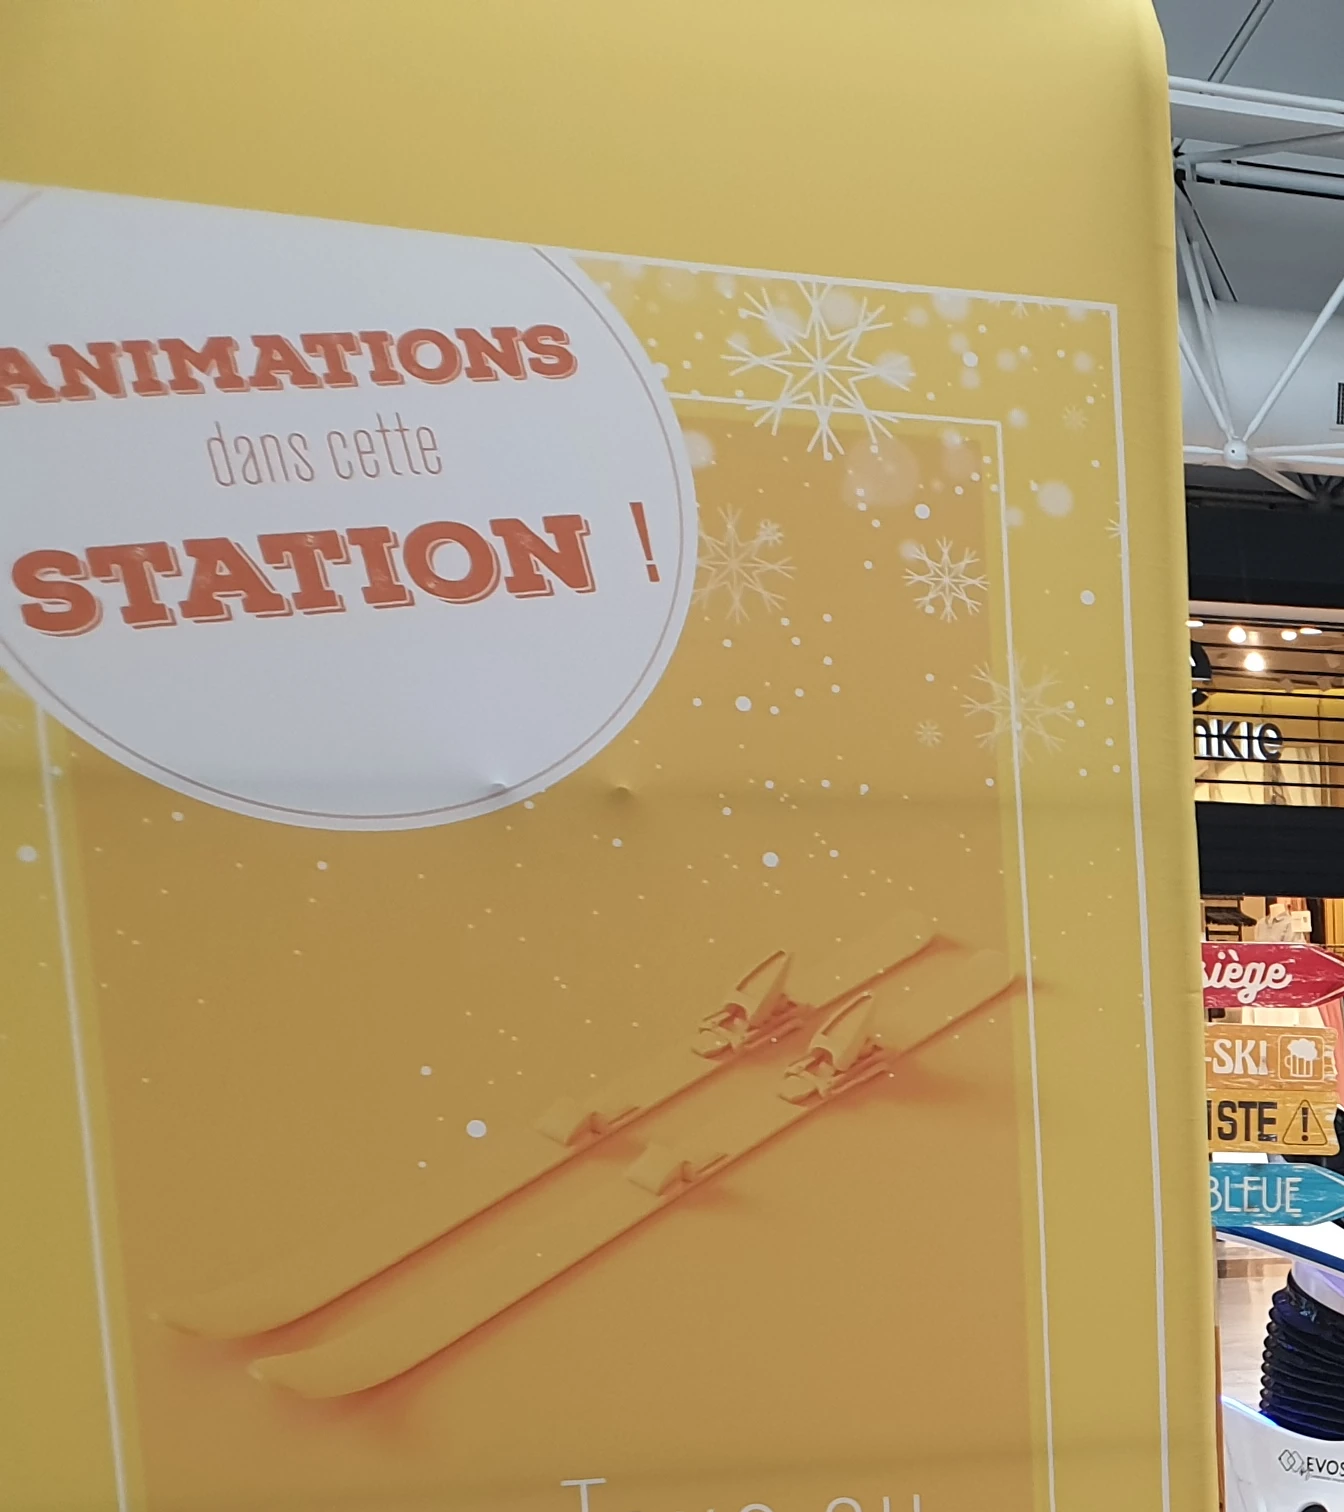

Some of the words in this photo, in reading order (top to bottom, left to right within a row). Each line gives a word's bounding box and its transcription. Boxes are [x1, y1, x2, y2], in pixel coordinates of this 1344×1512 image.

[0, 325, 578, 406] ANIMATIONS
[206, 421, 316, 488] dans
[327, 412, 443, 481] cette
[11, 514, 597, 638] STATION
[1210, 1174, 1303, 1213] BLEUE
